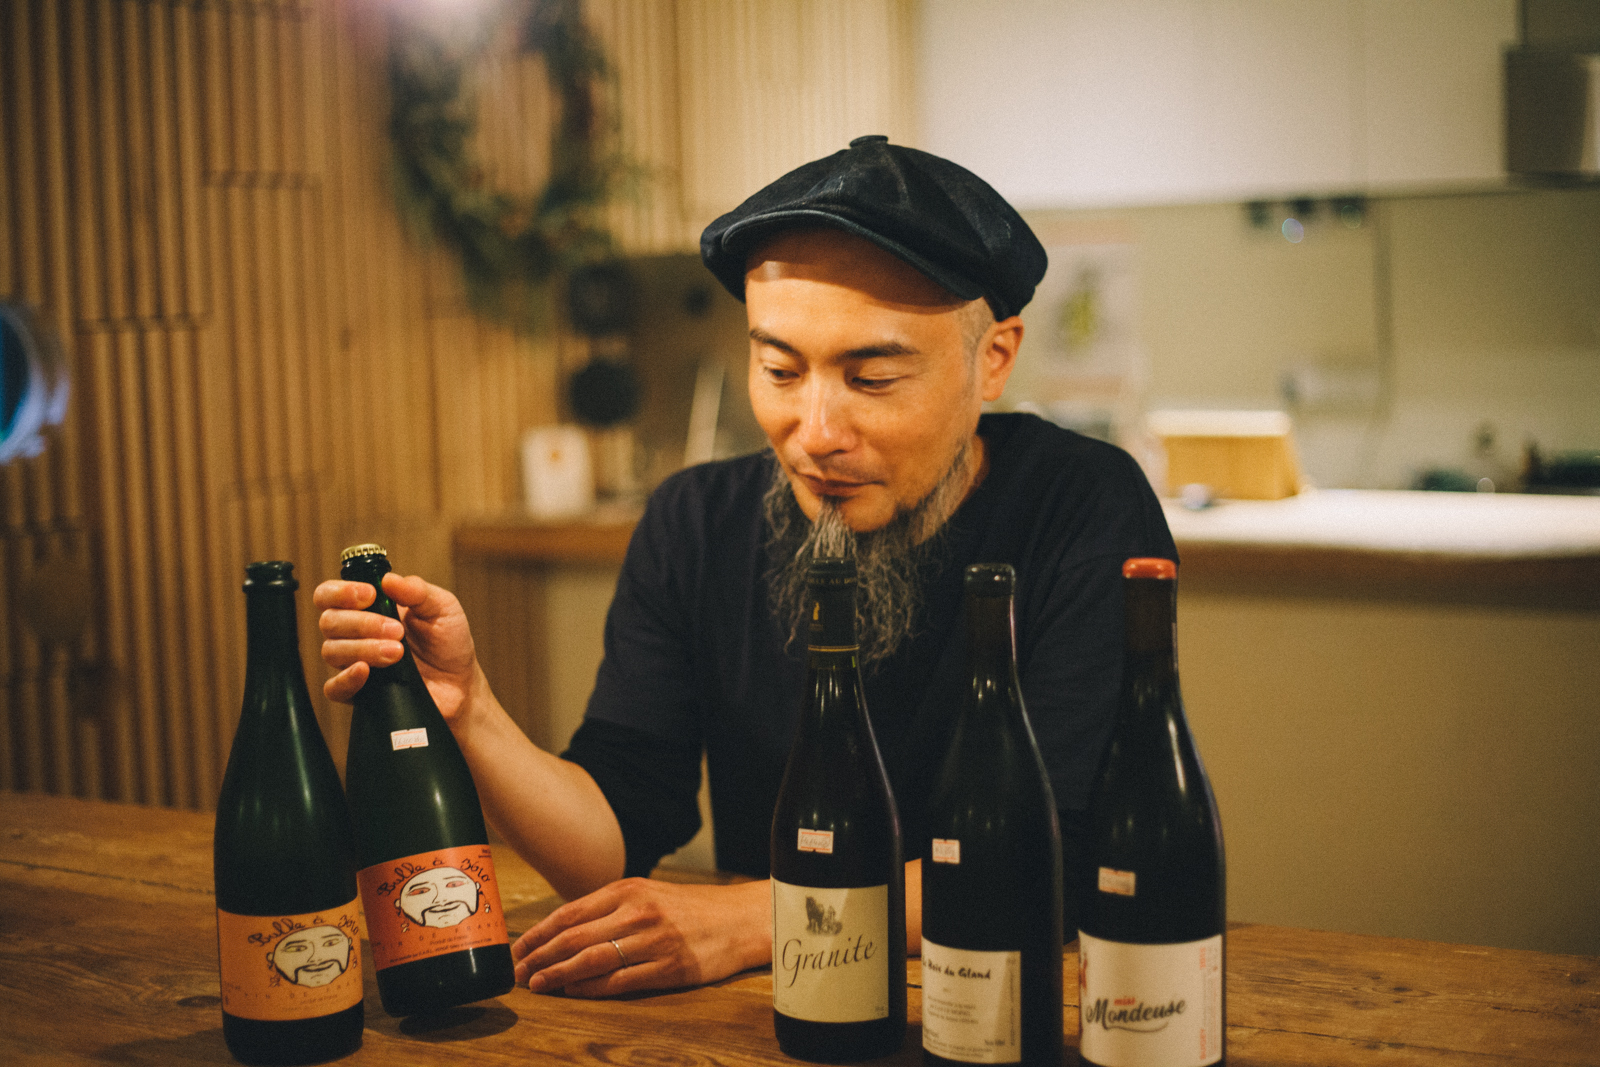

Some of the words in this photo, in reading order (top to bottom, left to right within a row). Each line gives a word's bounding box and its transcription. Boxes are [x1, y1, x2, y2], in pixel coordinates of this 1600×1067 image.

[376, 862, 426, 896] Bulle
[248, 917, 306, 947] Bulle
[782, 933, 878, 988] Granite
[958, 966, 991, 981] Gland
[1085, 996, 1186, 1031] Mondeuse
